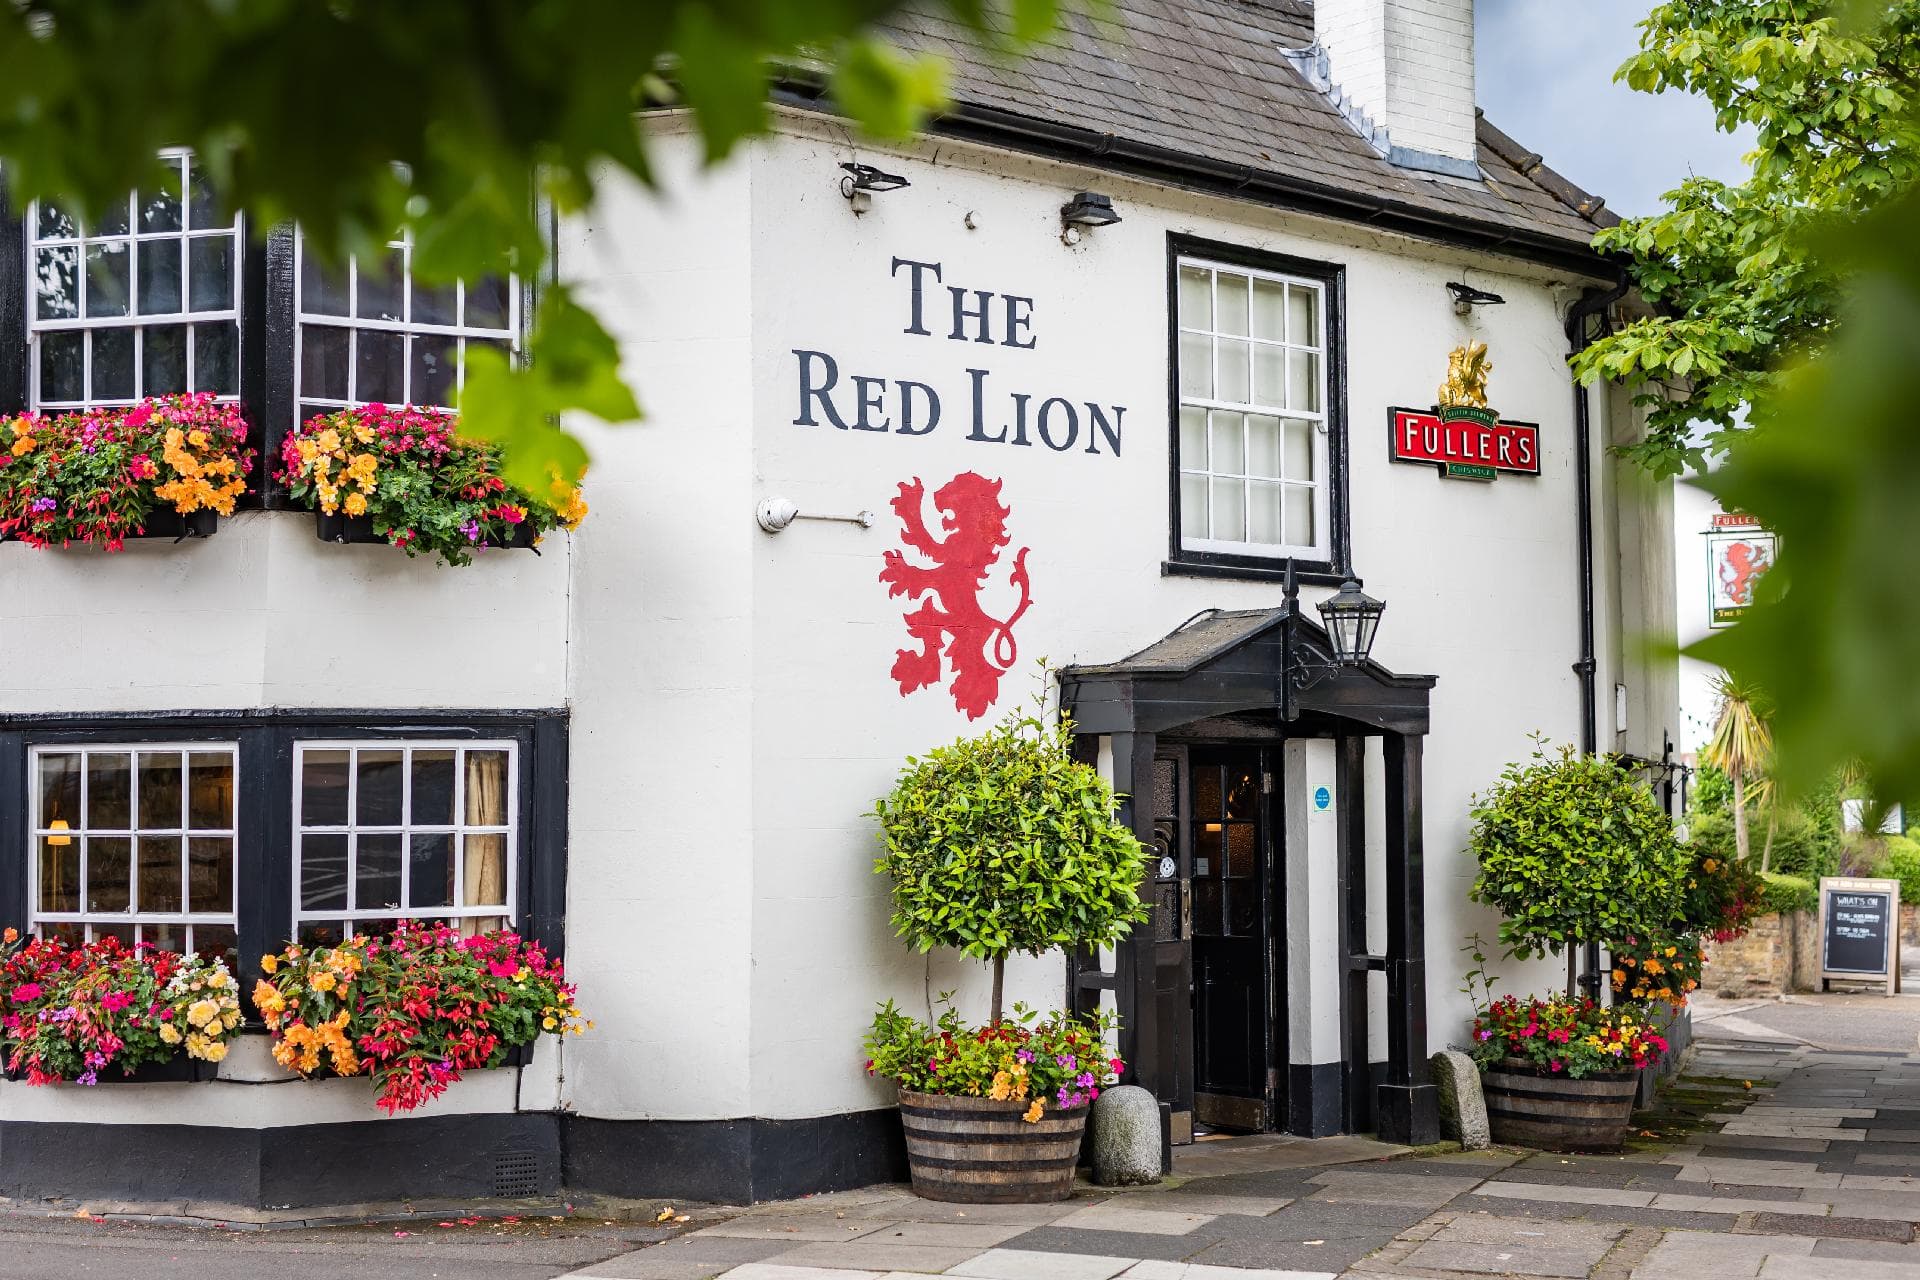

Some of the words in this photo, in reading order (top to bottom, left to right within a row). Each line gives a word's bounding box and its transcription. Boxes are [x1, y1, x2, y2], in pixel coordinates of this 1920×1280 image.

[892, 256, 1037, 349] THE
[792, 349, 941, 436] RED
[966, 368, 1127, 457] LION
[1405, 417, 1531, 465] FULLER'S
[1715, 516, 1760, 526] FULLER
